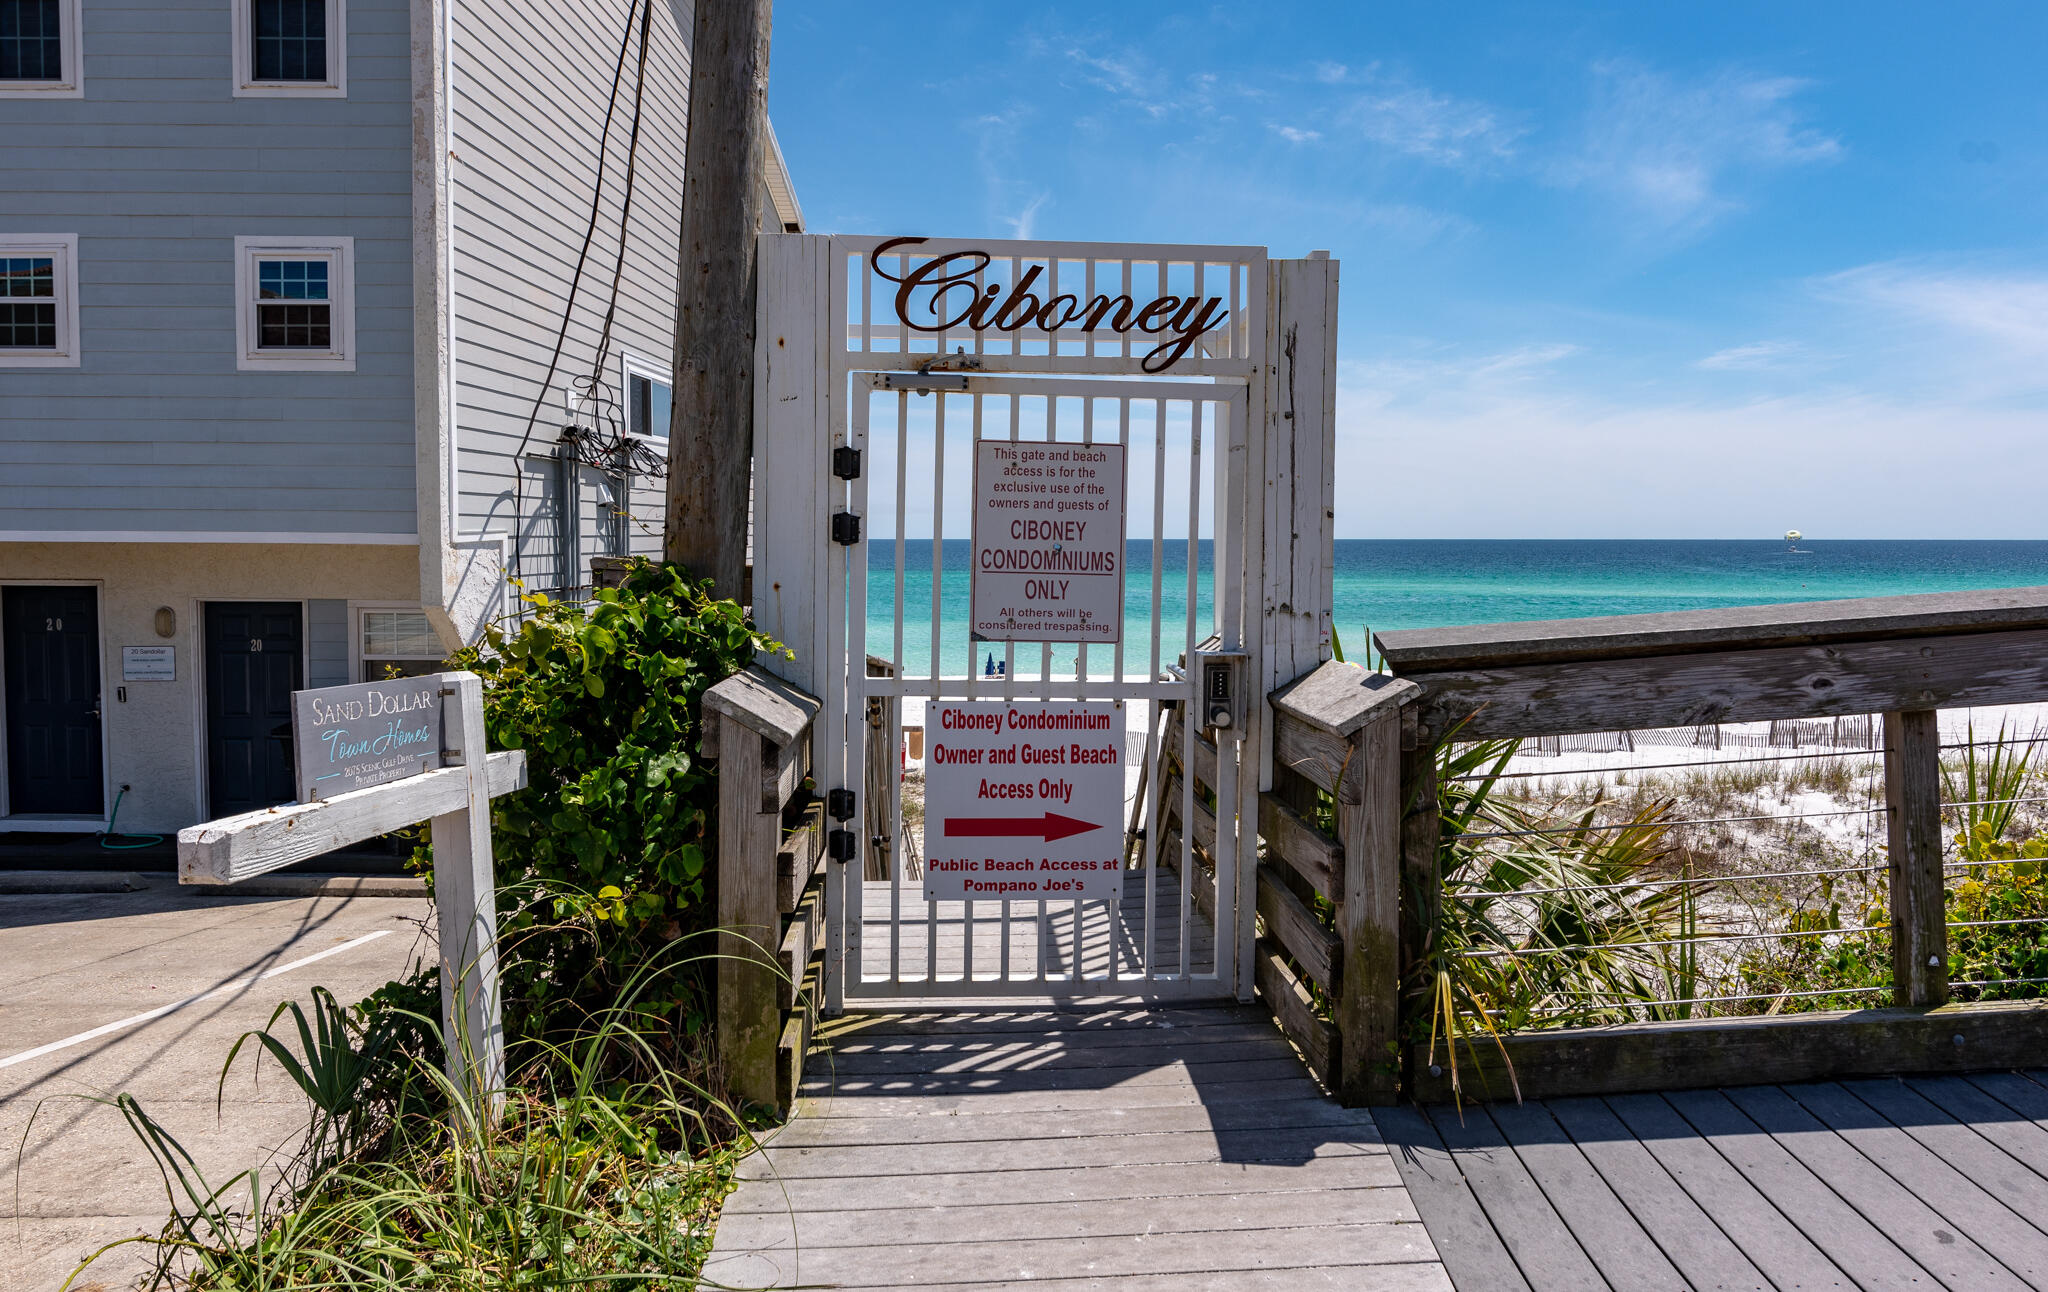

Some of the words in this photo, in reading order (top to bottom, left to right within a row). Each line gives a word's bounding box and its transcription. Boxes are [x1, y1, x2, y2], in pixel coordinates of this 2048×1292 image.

[871, 237, 1229, 373] Ciboney
[994, 448, 1017, 459] This
[1022, 449, 1045, 462] gate
[1049, 449, 1069, 461] and
[1073, 450, 1106, 462] beach
[1004, 467, 1042, 476] access
[1046, 466, 1055, 477] is
[1060, 466, 1073, 477] for
[1078, 467, 1095, 478] the
[993, 482, 1046, 493] exclusive
[1050, 484, 1069, 493] use
[1074, 483, 1085, 494] of
[1087, 483, 1104, 495] the
[989, 499, 1029, 509] owners
[1034, 498, 1054, 509] and
[1058, 500, 1094, 512] guests
[1098, 500, 1109, 510] of
[1011, 520, 1087, 541] CIBONEY
[981, 549, 1114, 571] CONDOMINIUMS
[1025, 579, 1069, 600] ONLY
[1000, 608, 1014, 617] All
[1018, 608, 1053, 618] others
[1057, 609, 1076, 618] will
[1079, 609, 1092, 618] be
[46, 618, 62, 631] 20
[979, 619, 1041, 630] considered
[1044, 622, 1112, 633] trespassing.
[250, 639, 262, 652] 20
[942, 709, 1003, 734] Ciboney
[1008, 709, 1110, 730] Condominium
[322, 729, 372, 762] Town
[372, 719, 430, 755] Homes
[934, 744, 984, 764] Owner
[989, 744, 1016, 764] and
[1021, 744, 1065, 764] Guest
[1070, 744, 1117, 764] Beach
[978, 778, 1034, 799] Access
[1039, 778, 1072, 804] Only
[929, 859, 979, 871] Public
[984, 859, 1034, 871] Beach
[1040, 858, 1097, 870] Access
[1103, 859, 1118, 870] at
[964, 879, 1037, 894] Pompano
[1043, 878, 1084, 891] Joe's
